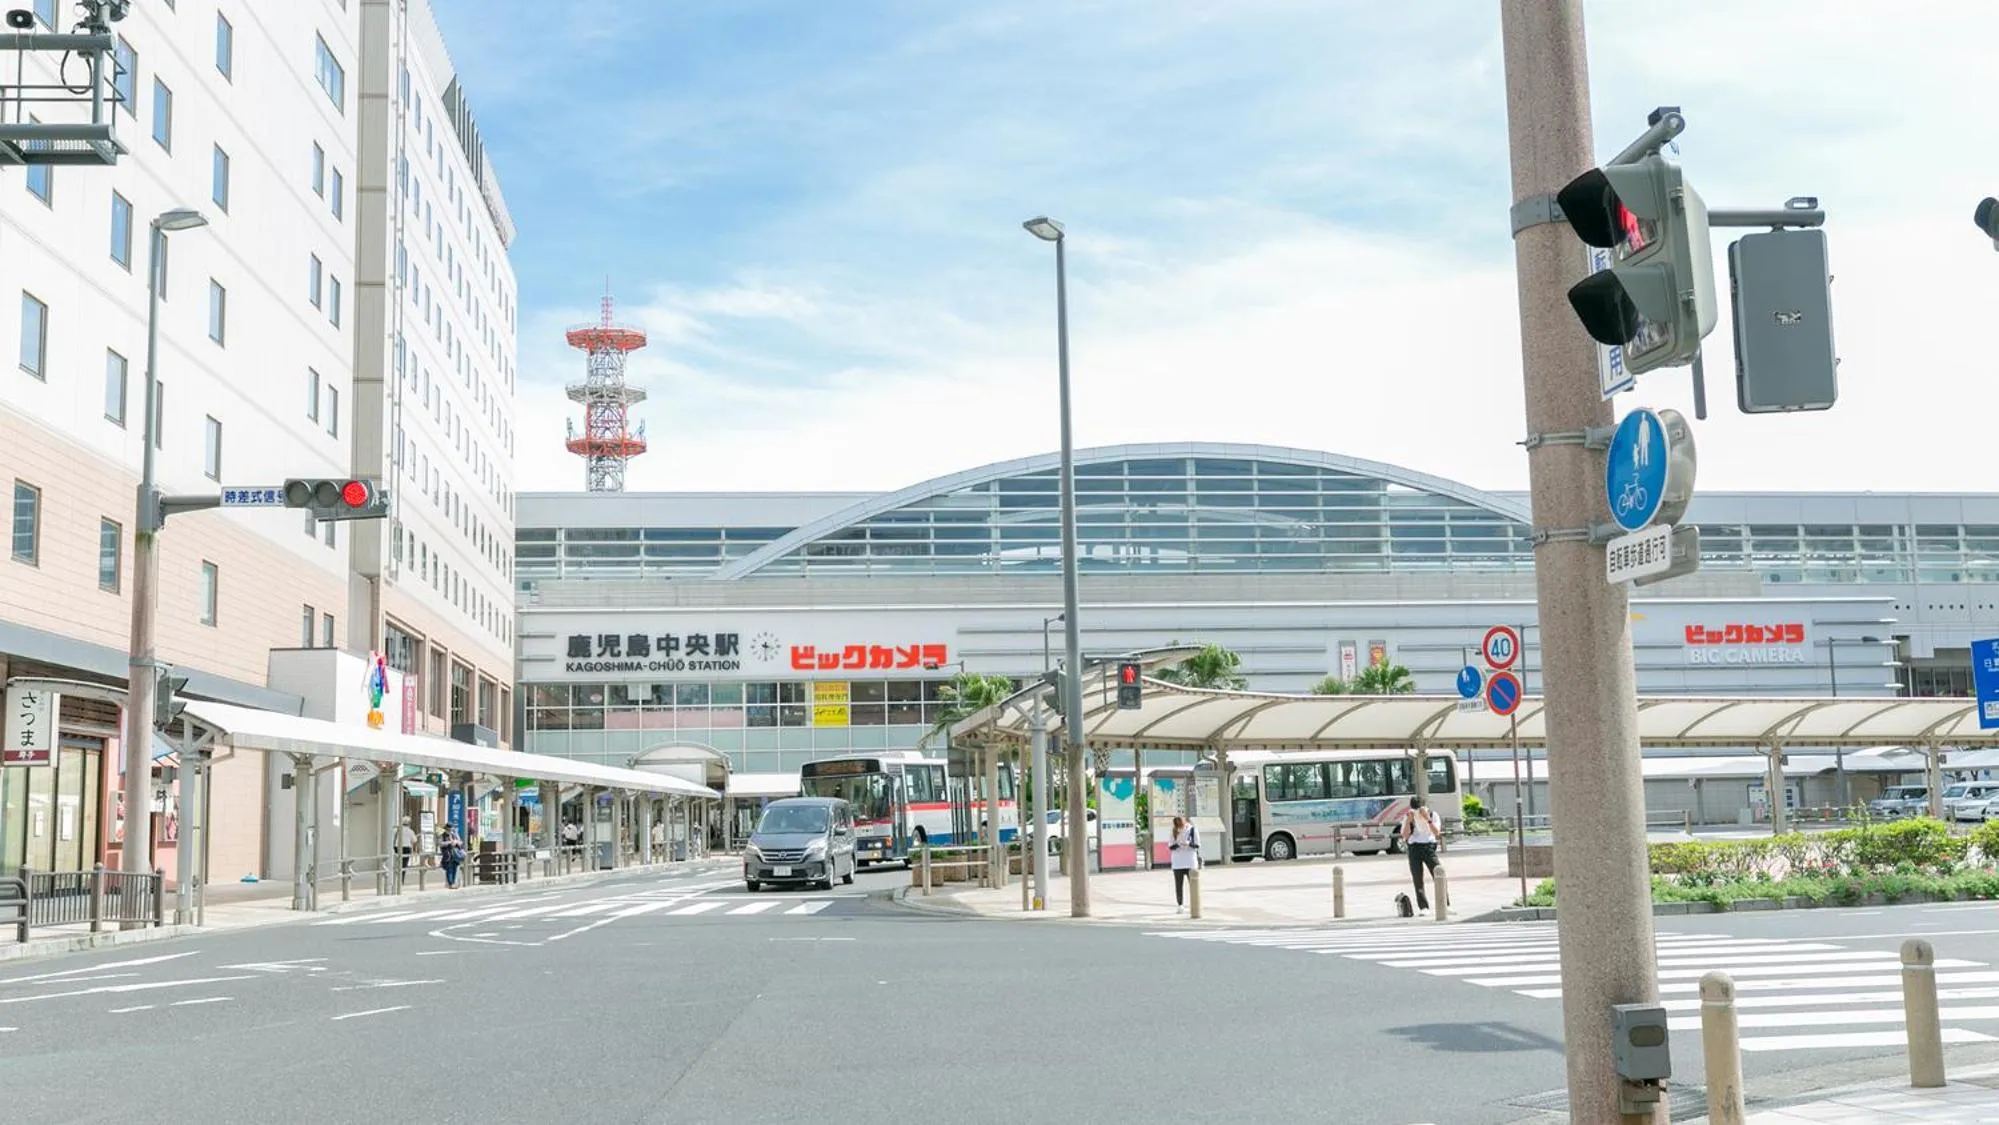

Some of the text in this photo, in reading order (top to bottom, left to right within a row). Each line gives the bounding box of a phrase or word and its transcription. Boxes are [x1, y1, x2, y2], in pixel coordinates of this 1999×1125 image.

[1685, 624, 1804, 644] ビックカメラ
[567, 632, 739, 658] 鹿児島中央駅
[1491, 638, 1510, 657] 40
[688, 660, 740, 671] STATION
[790, 644, 947, 671] ビックカメラ
[1691, 648, 1804, 664] BIC CAMERA
[20, 691, 37, 747] さつま
